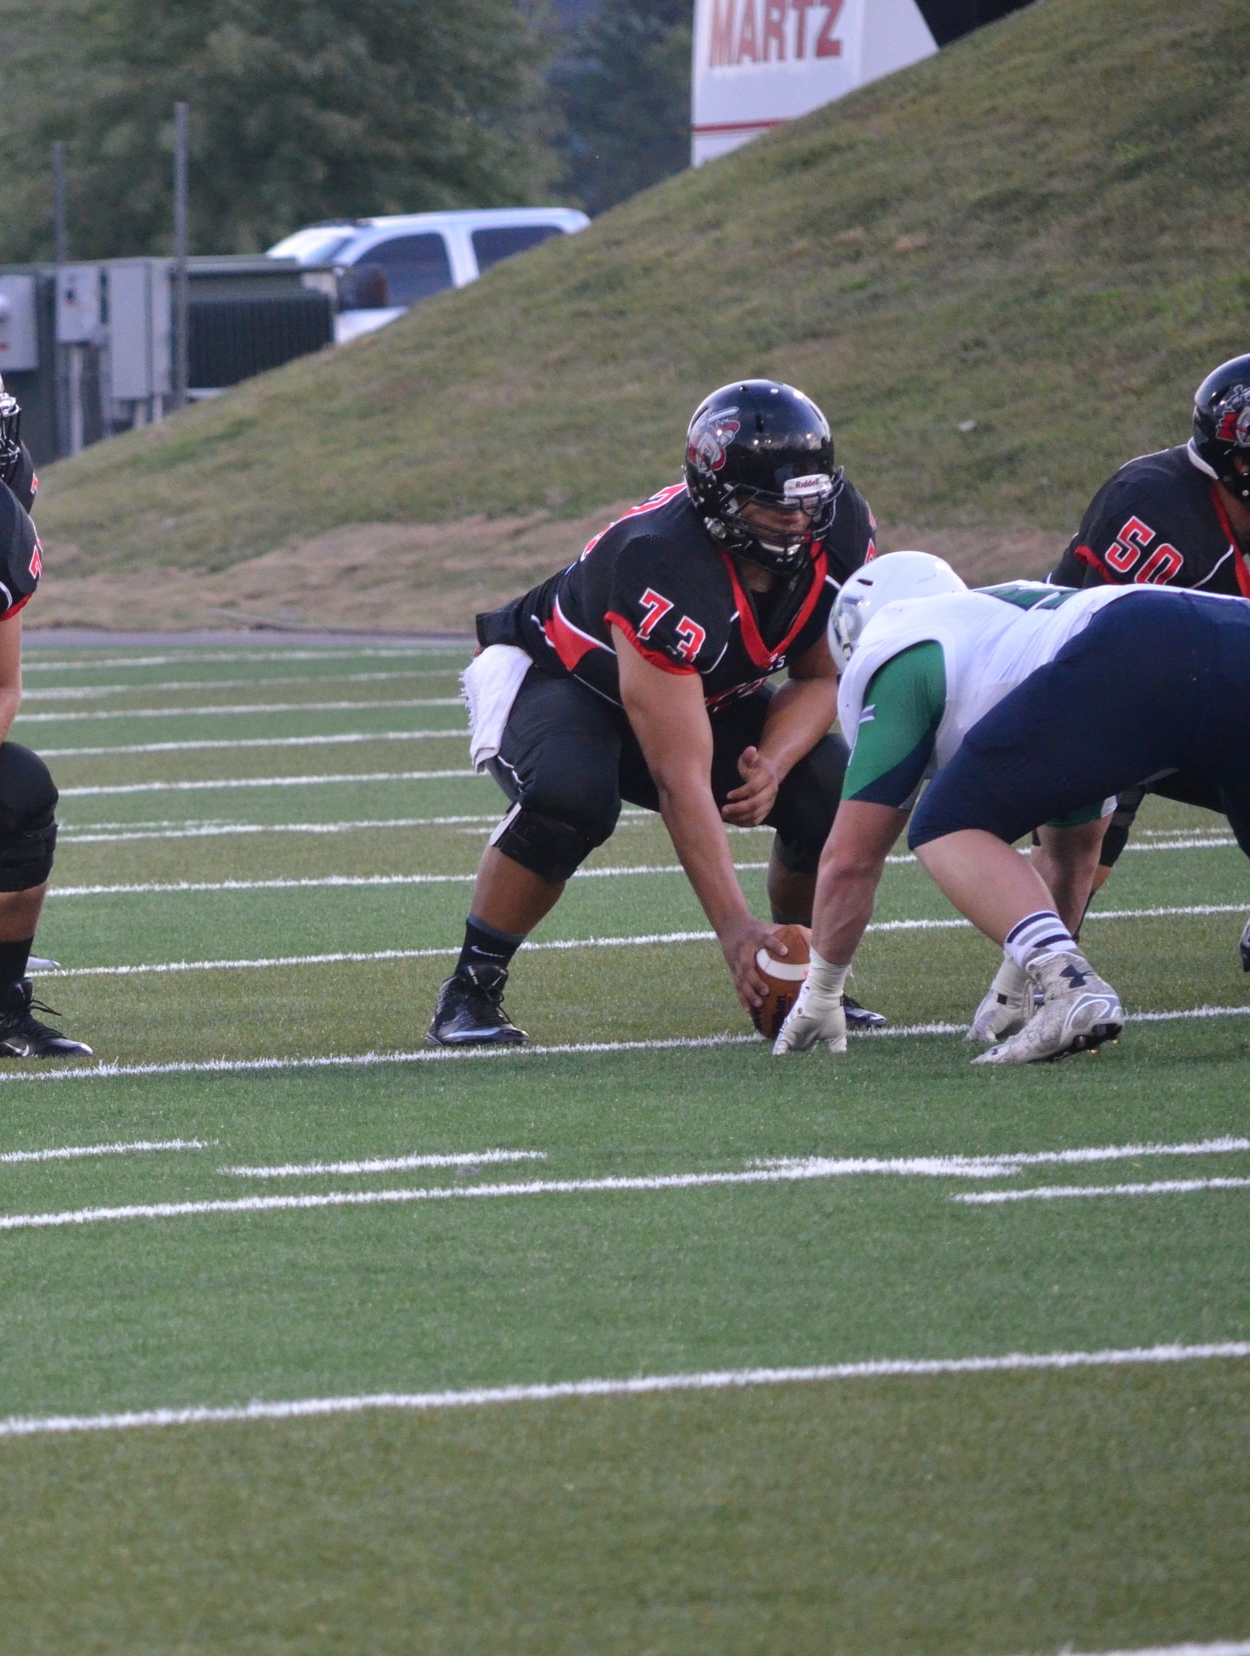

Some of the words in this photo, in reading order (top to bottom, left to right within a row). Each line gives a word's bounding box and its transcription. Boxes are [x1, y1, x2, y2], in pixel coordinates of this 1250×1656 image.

[708, 0, 845, 67] MARTZ
[795, 479, 820, 489] Riddell
[1105, 516, 1184, 585] 50
[639, 588, 706, 663] 73
